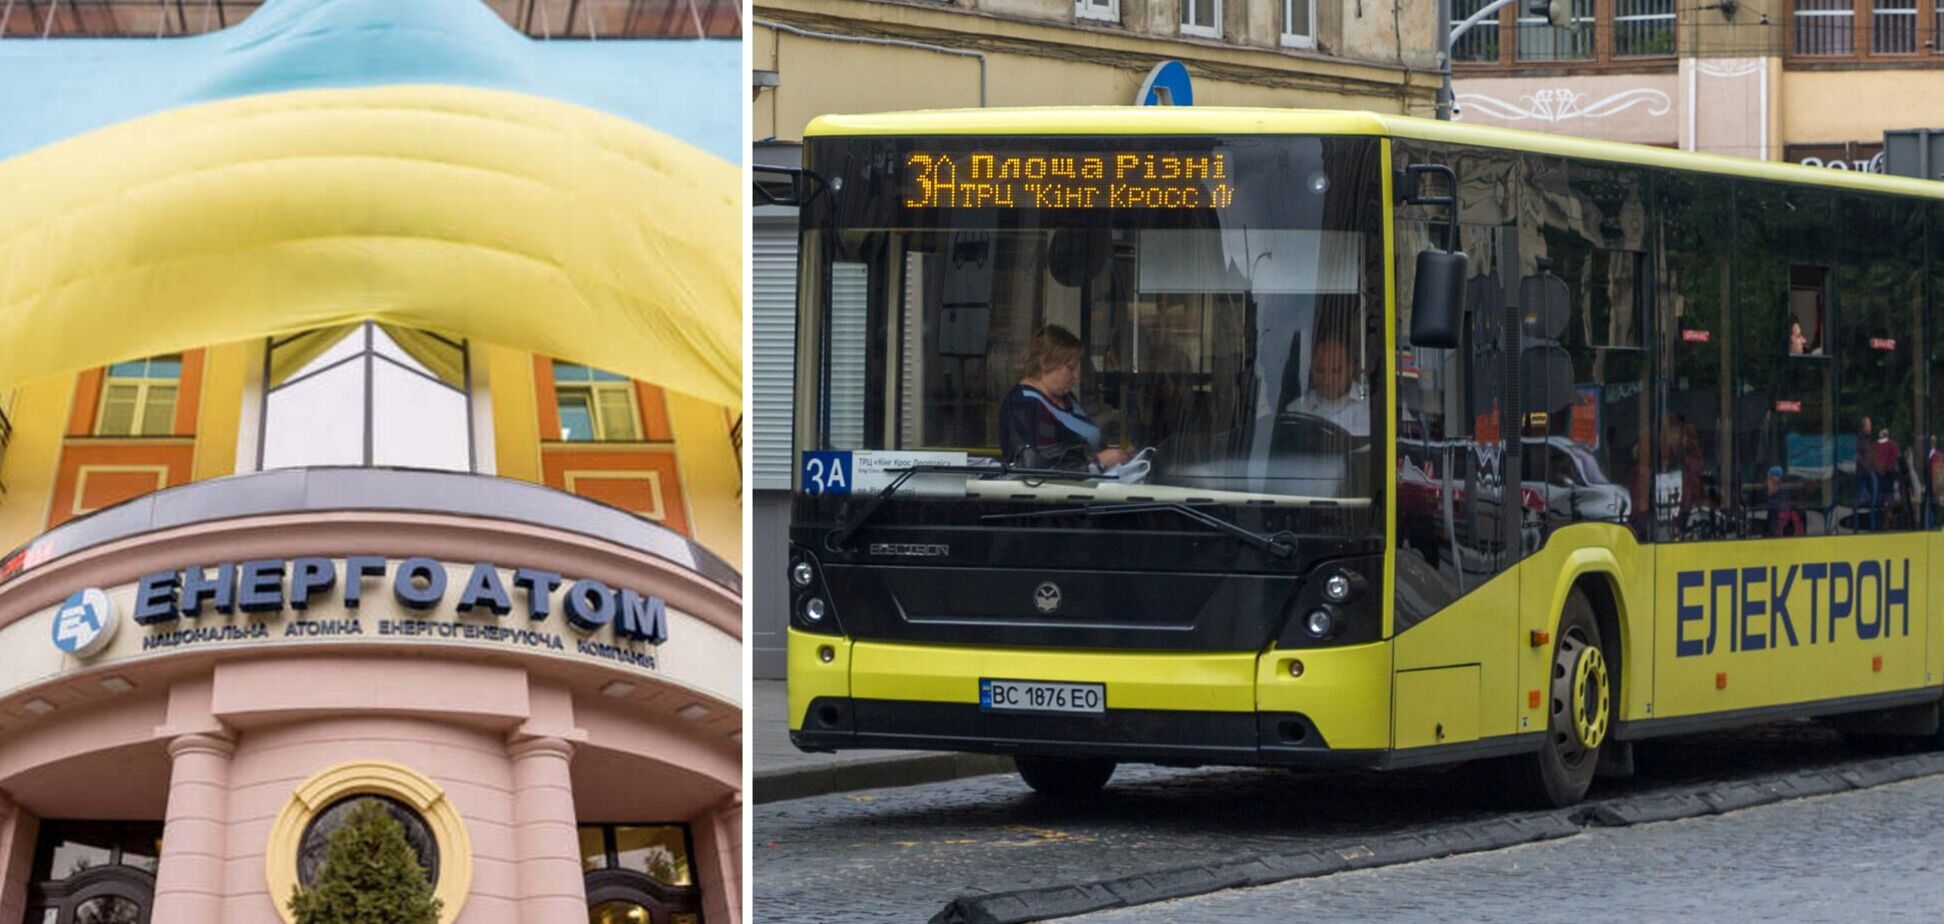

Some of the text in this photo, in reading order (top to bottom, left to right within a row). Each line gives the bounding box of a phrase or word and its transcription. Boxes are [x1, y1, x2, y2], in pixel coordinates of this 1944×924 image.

[971, 154, 1103, 179] Площа
[1116, 154, 1226, 179] Різні
[960, 184, 1014, 208] ТРЦ
[1024, 184, 1100, 208] "Кінг
[1110, 184, 1199, 208] Кросс
[134, 555, 668, 645] ЕНЕРГОАТОМ
[1676, 558, 1910, 658] ЕЛЕКТРОН
[143, 619, 656, 669] НАЦІОНАЛЬНА АТОМНА ЕНЕРГОГЕНЕРУЮЧА КОМПАНІЯ
[1025, 686, 1066, 707] 1876
